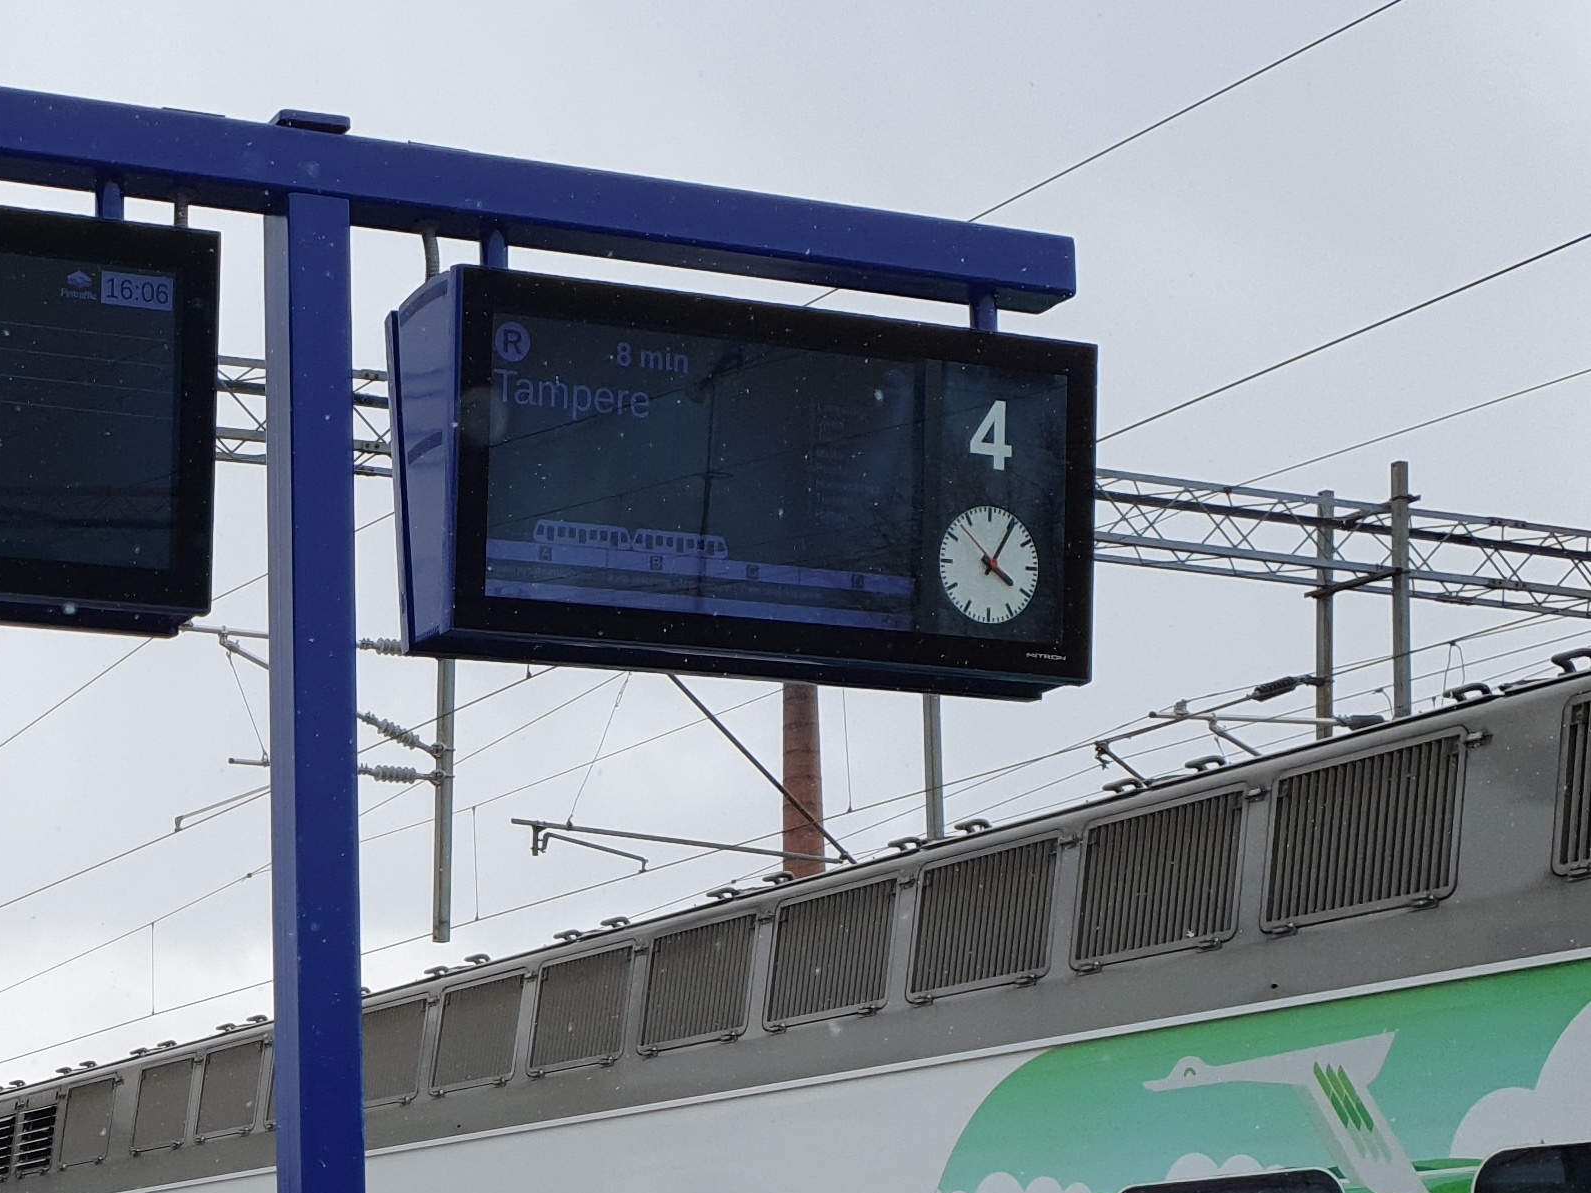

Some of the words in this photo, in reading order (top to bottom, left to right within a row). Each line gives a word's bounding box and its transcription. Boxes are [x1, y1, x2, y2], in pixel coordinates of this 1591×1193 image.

[107, 277, 169, 304] 16:06
[502, 328, 523, 355] R
[616, 342, 632, 367] 8
[640, 347, 689, 373] min
[494, 368, 651, 420] Tampere
[969, 400, 1012, 471] 4
